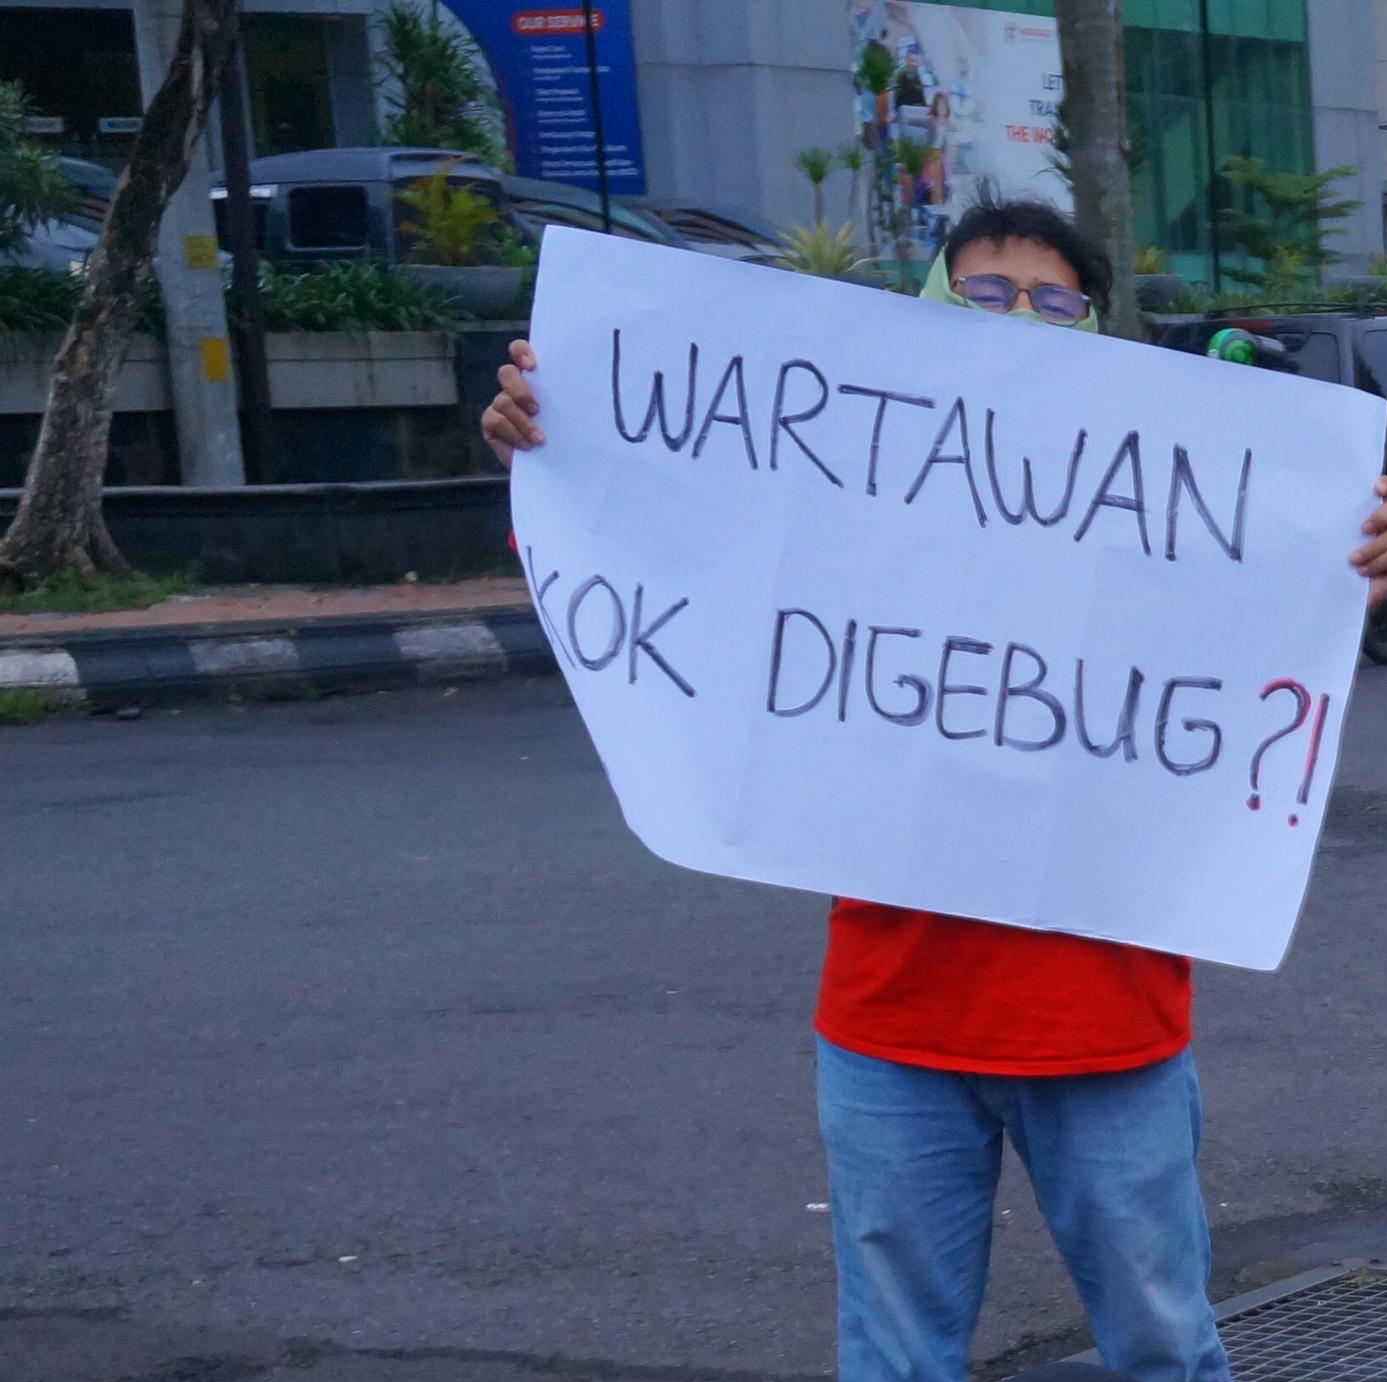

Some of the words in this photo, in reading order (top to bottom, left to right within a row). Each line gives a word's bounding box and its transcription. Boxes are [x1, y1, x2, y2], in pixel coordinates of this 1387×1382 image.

[1028, 99, 1058, 116] TRA
[611, 327, 1252, 564] WARTAWAN
[526, 545, 696, 698] KOK
[766, 606, 1330, 828] DIGEBUG?!
